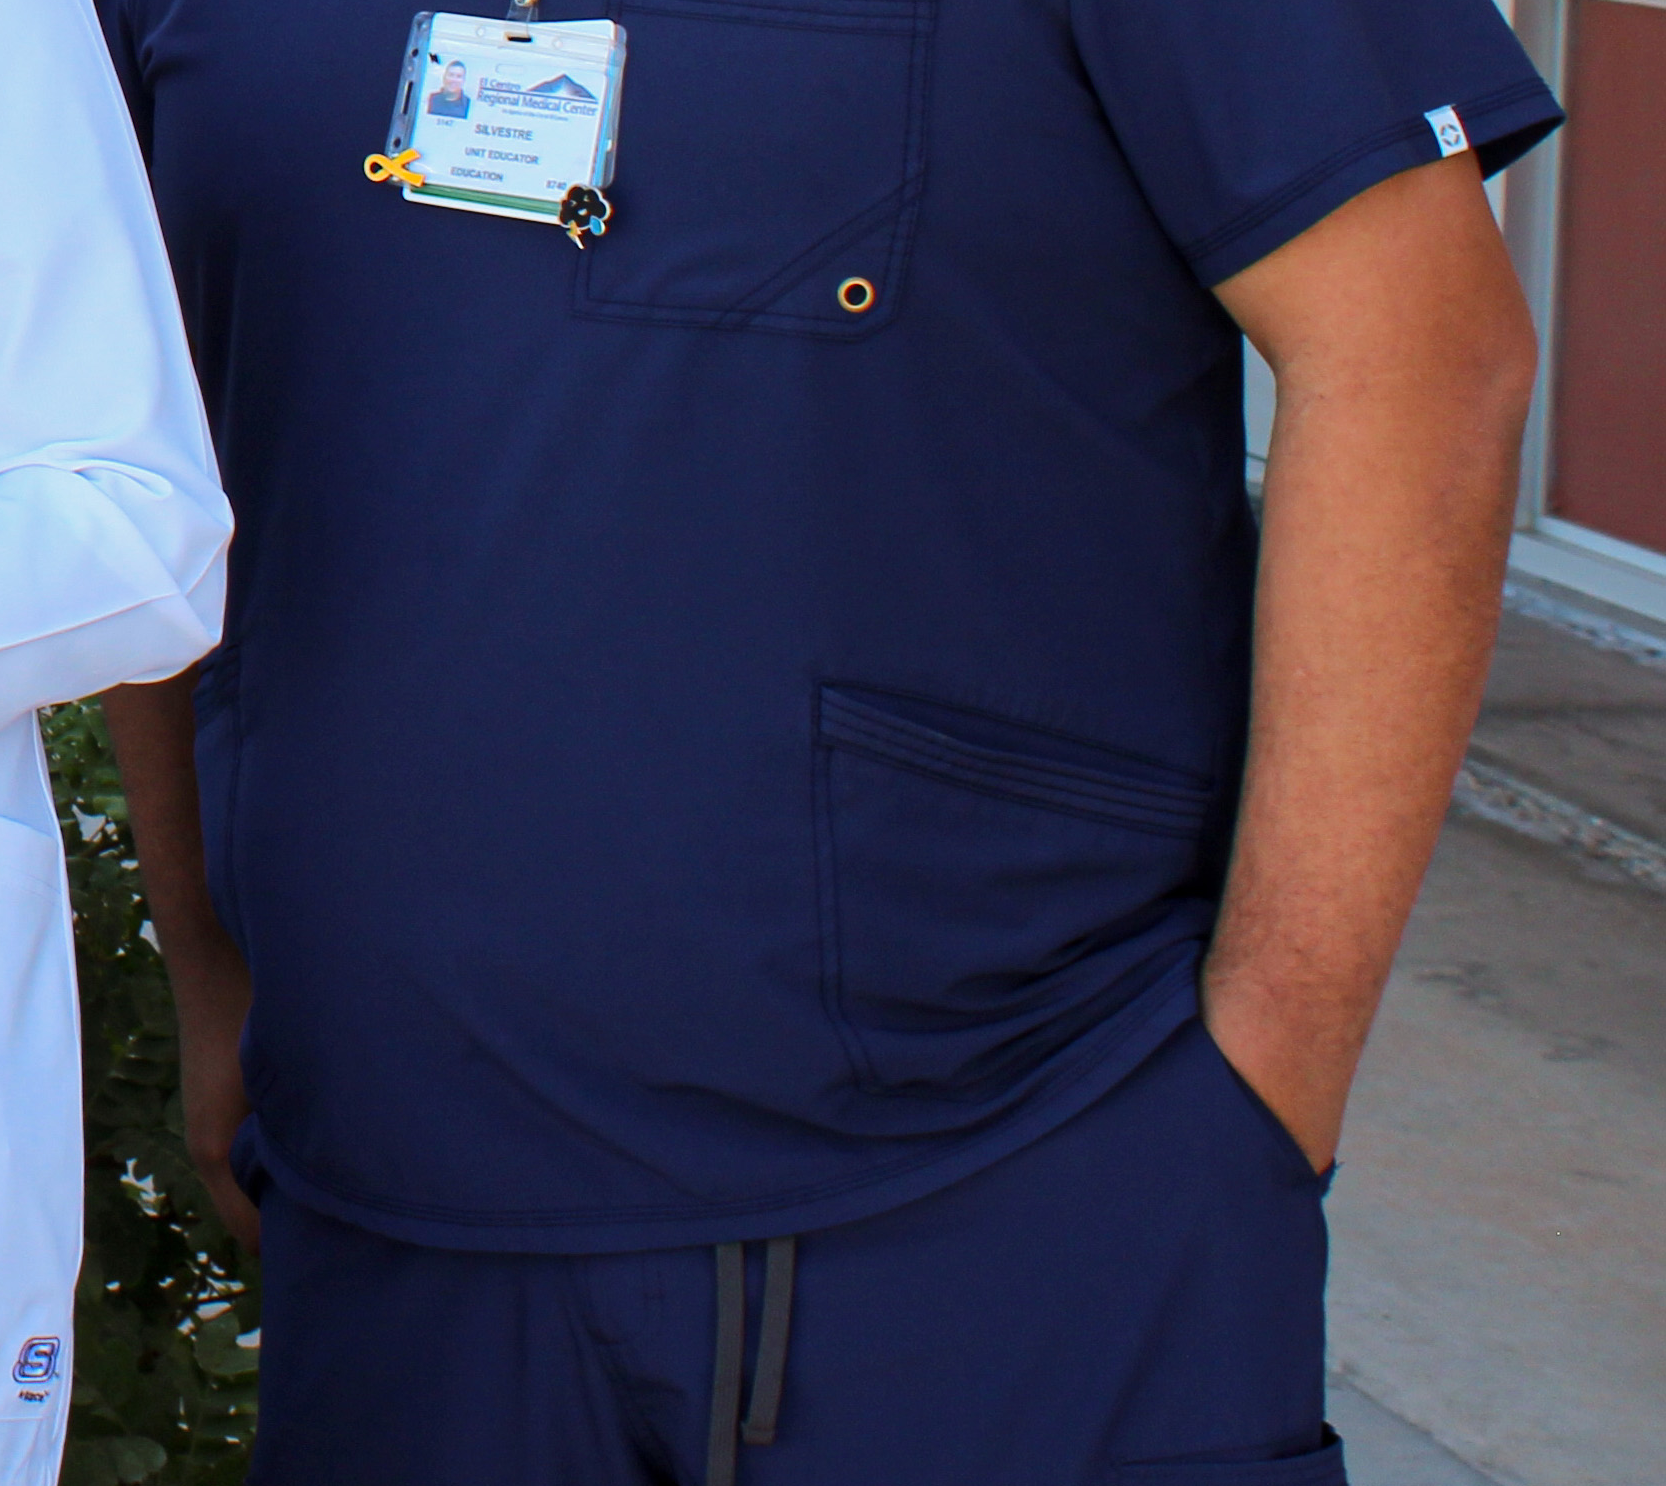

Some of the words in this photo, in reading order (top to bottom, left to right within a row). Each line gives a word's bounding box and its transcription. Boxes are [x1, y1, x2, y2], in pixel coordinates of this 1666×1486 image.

[490, 79, 522, 91] Centro
[477, 90, 520, 106] Regional
[522, 96, 561, 112] Medical
[563, 102, 598, 115] Center
[475, 123, 534, 141] SILVESTRE
[465, 147, 486, 157] UNIT
[488, 149, 539, 164] EDUCATOR
[450, 166, 503, 182] EDUCATION
